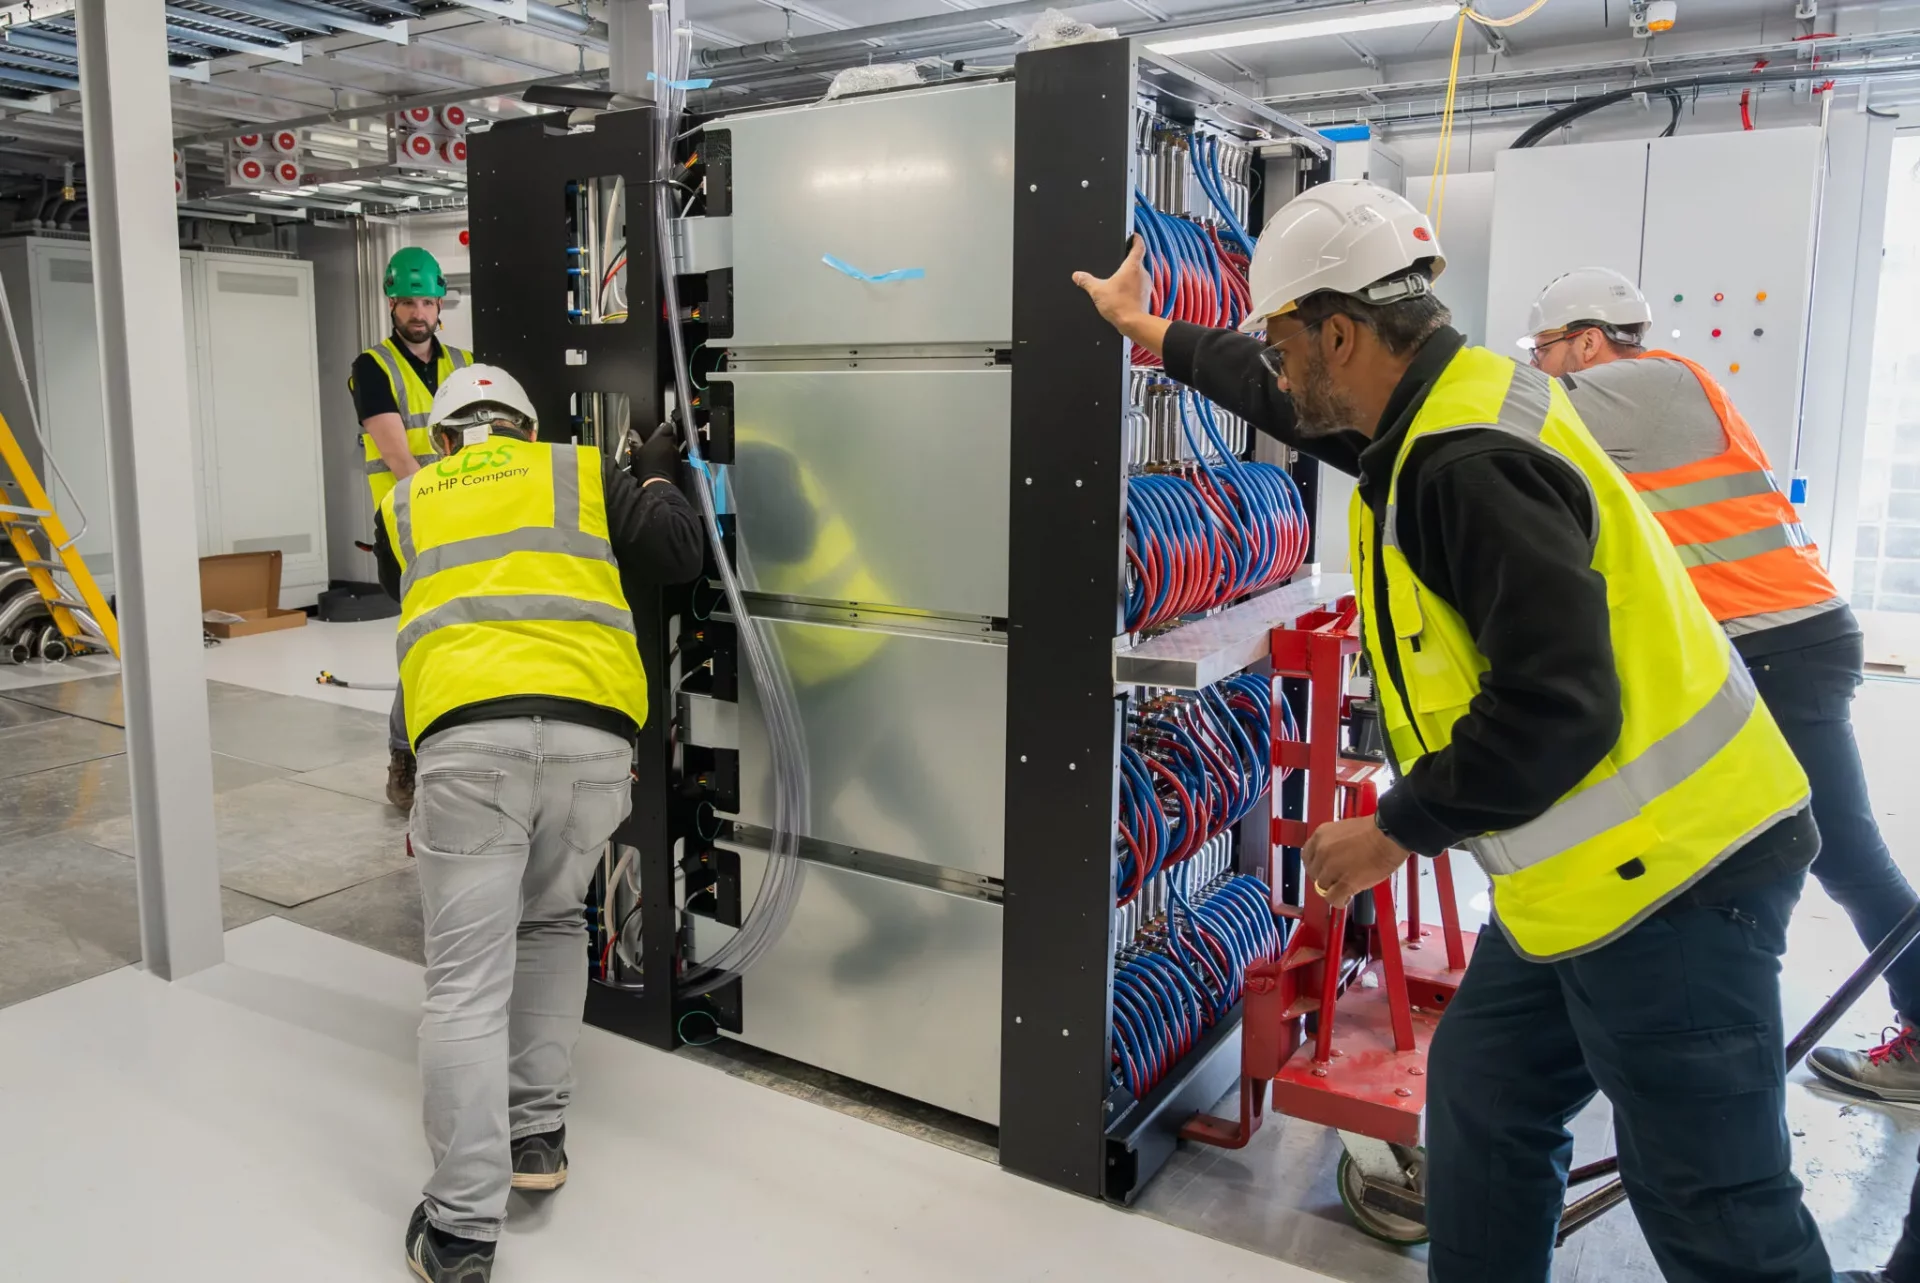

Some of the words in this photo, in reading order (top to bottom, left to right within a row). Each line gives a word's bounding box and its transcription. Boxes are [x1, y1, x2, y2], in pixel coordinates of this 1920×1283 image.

[436, 444, 515, 477] CDS
[416, 486, 434, 499] An
[438, 477, 458, 491] HP
[461, 467, 529, 486] Company
